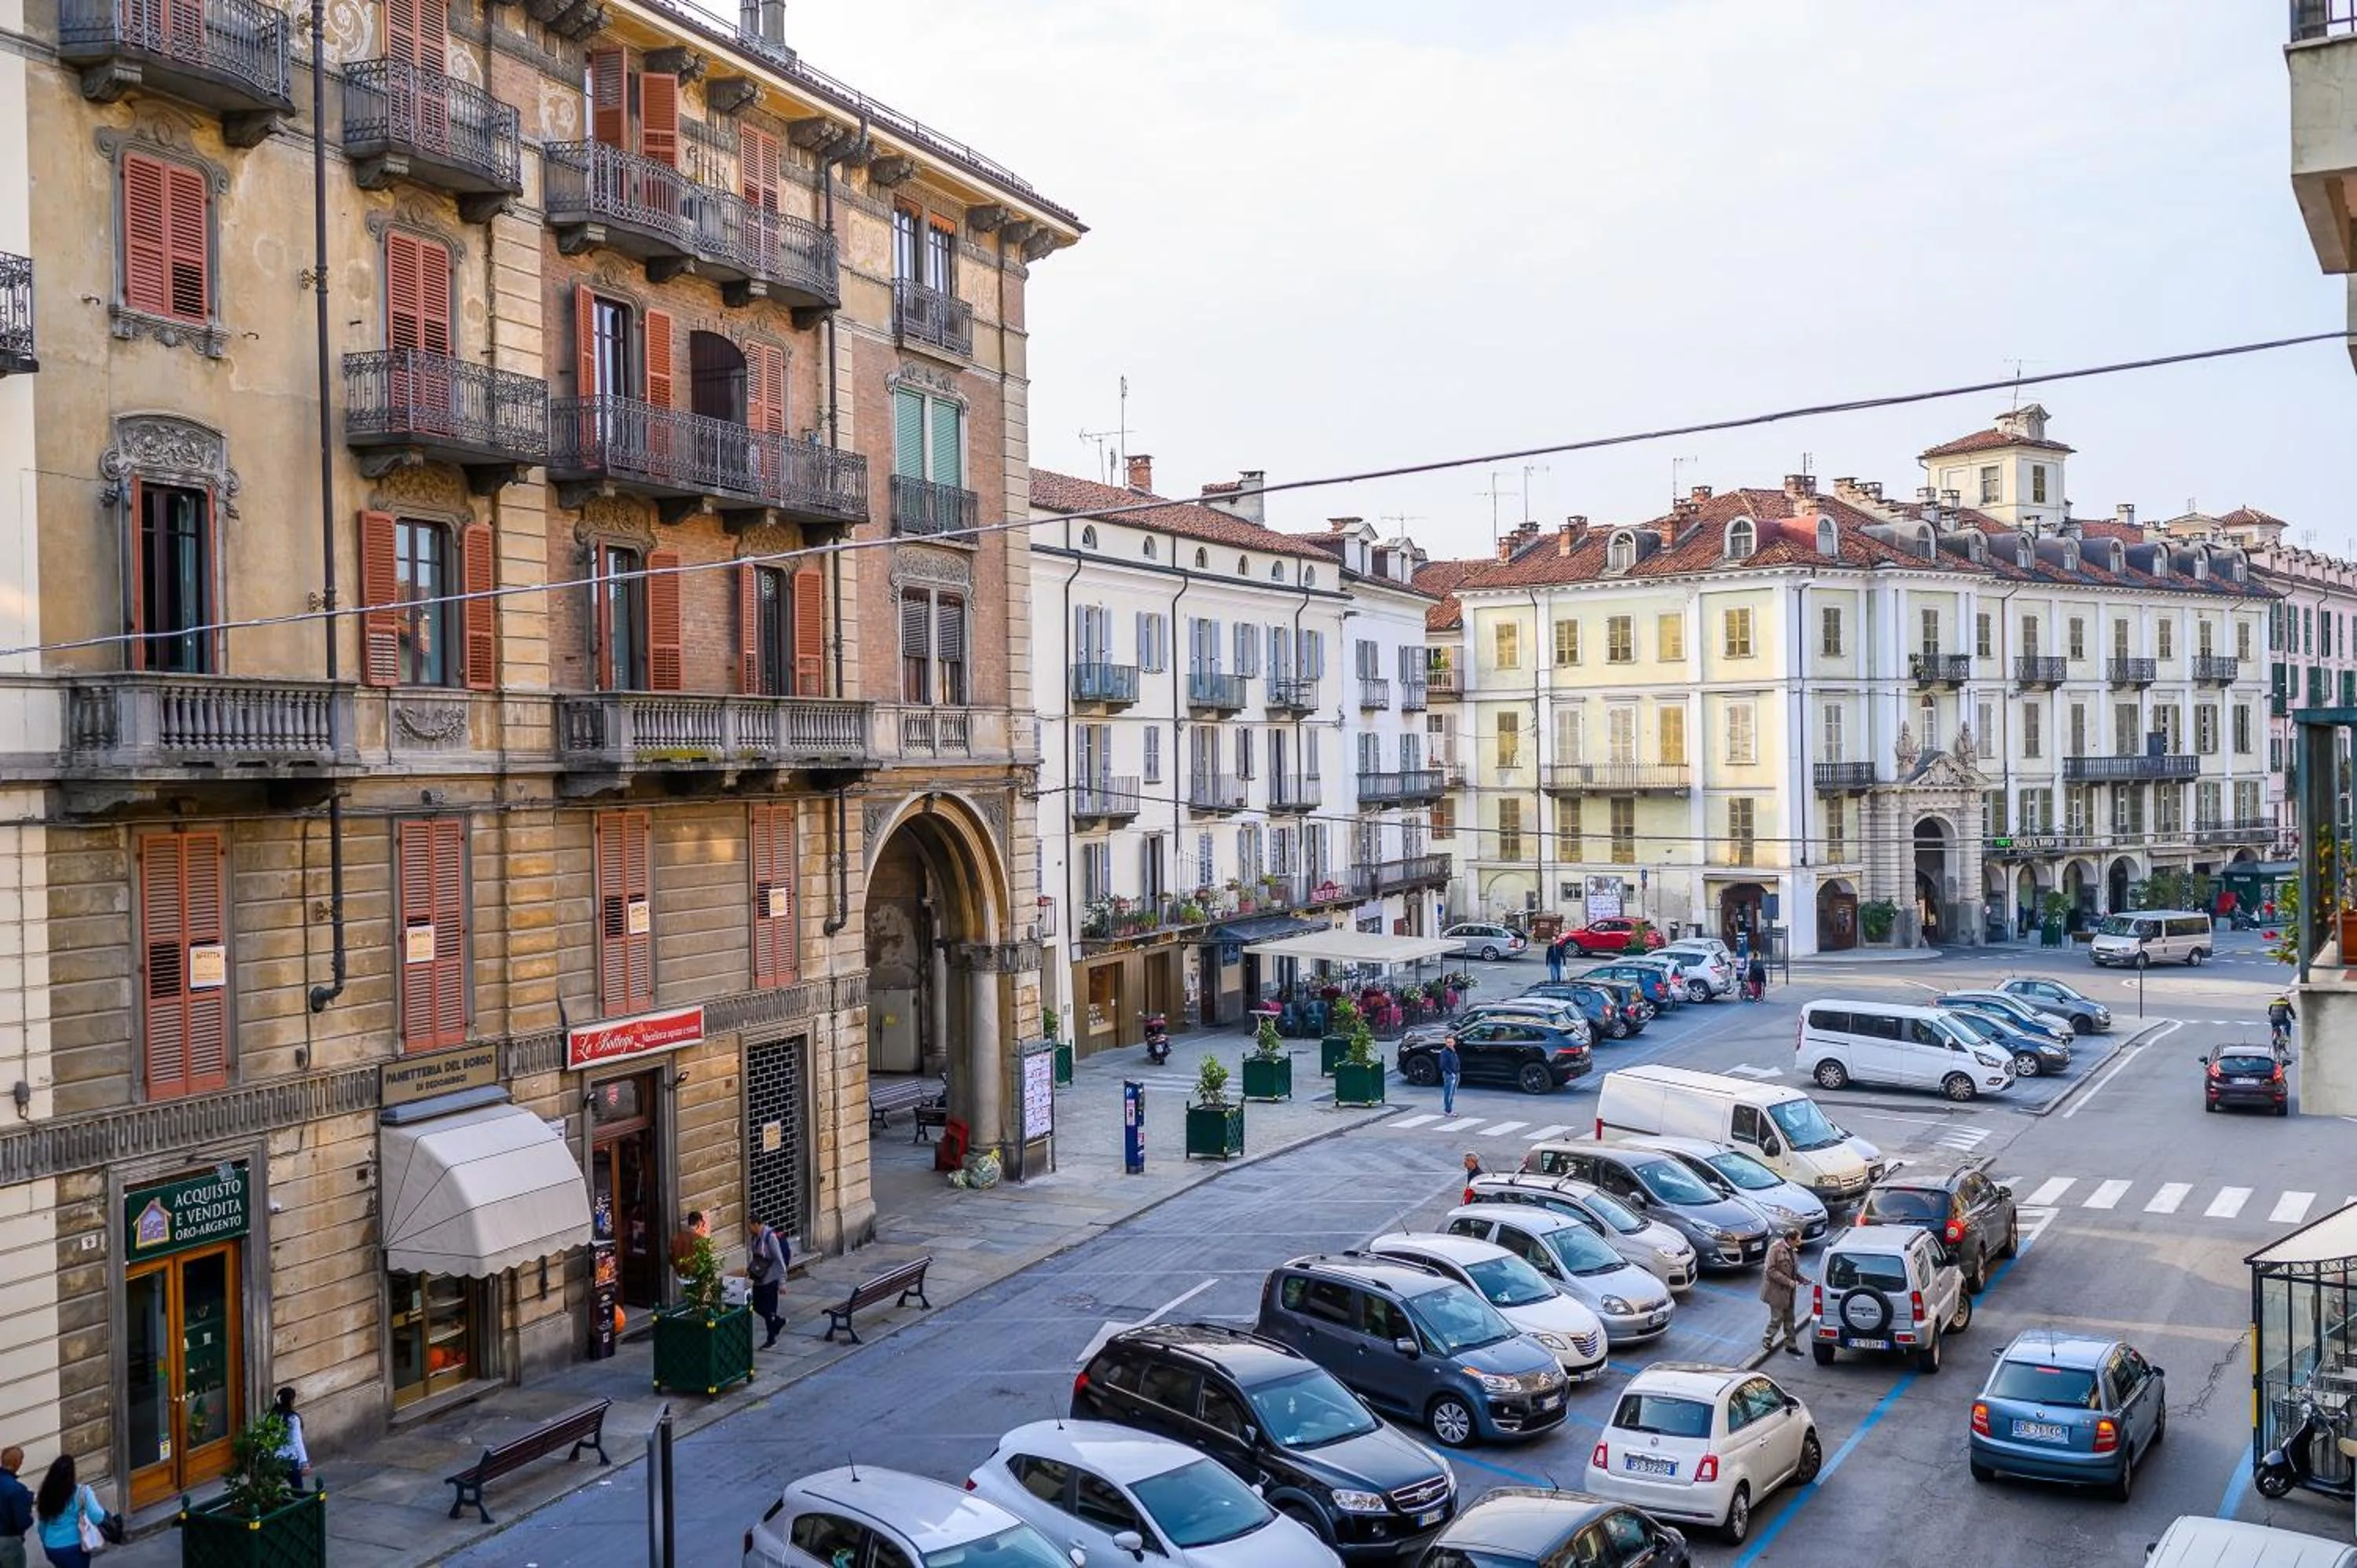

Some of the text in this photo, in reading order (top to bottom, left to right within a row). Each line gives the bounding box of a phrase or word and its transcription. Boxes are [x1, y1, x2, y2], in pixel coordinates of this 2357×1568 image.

[596, 1031, 634, 1053] Bottega
[386, 1063, 442, 1085] PANETTERIA
[444, 1061, 461, 1073] DEL
[464, 1054, 493, 1069] BORGO
[174, 1179, 241, 1207] ACQUISTO
[175, 1199, 241, 1226] E VENDITA
[175, 1215, 242, 1241] ORO-ARGENTO
